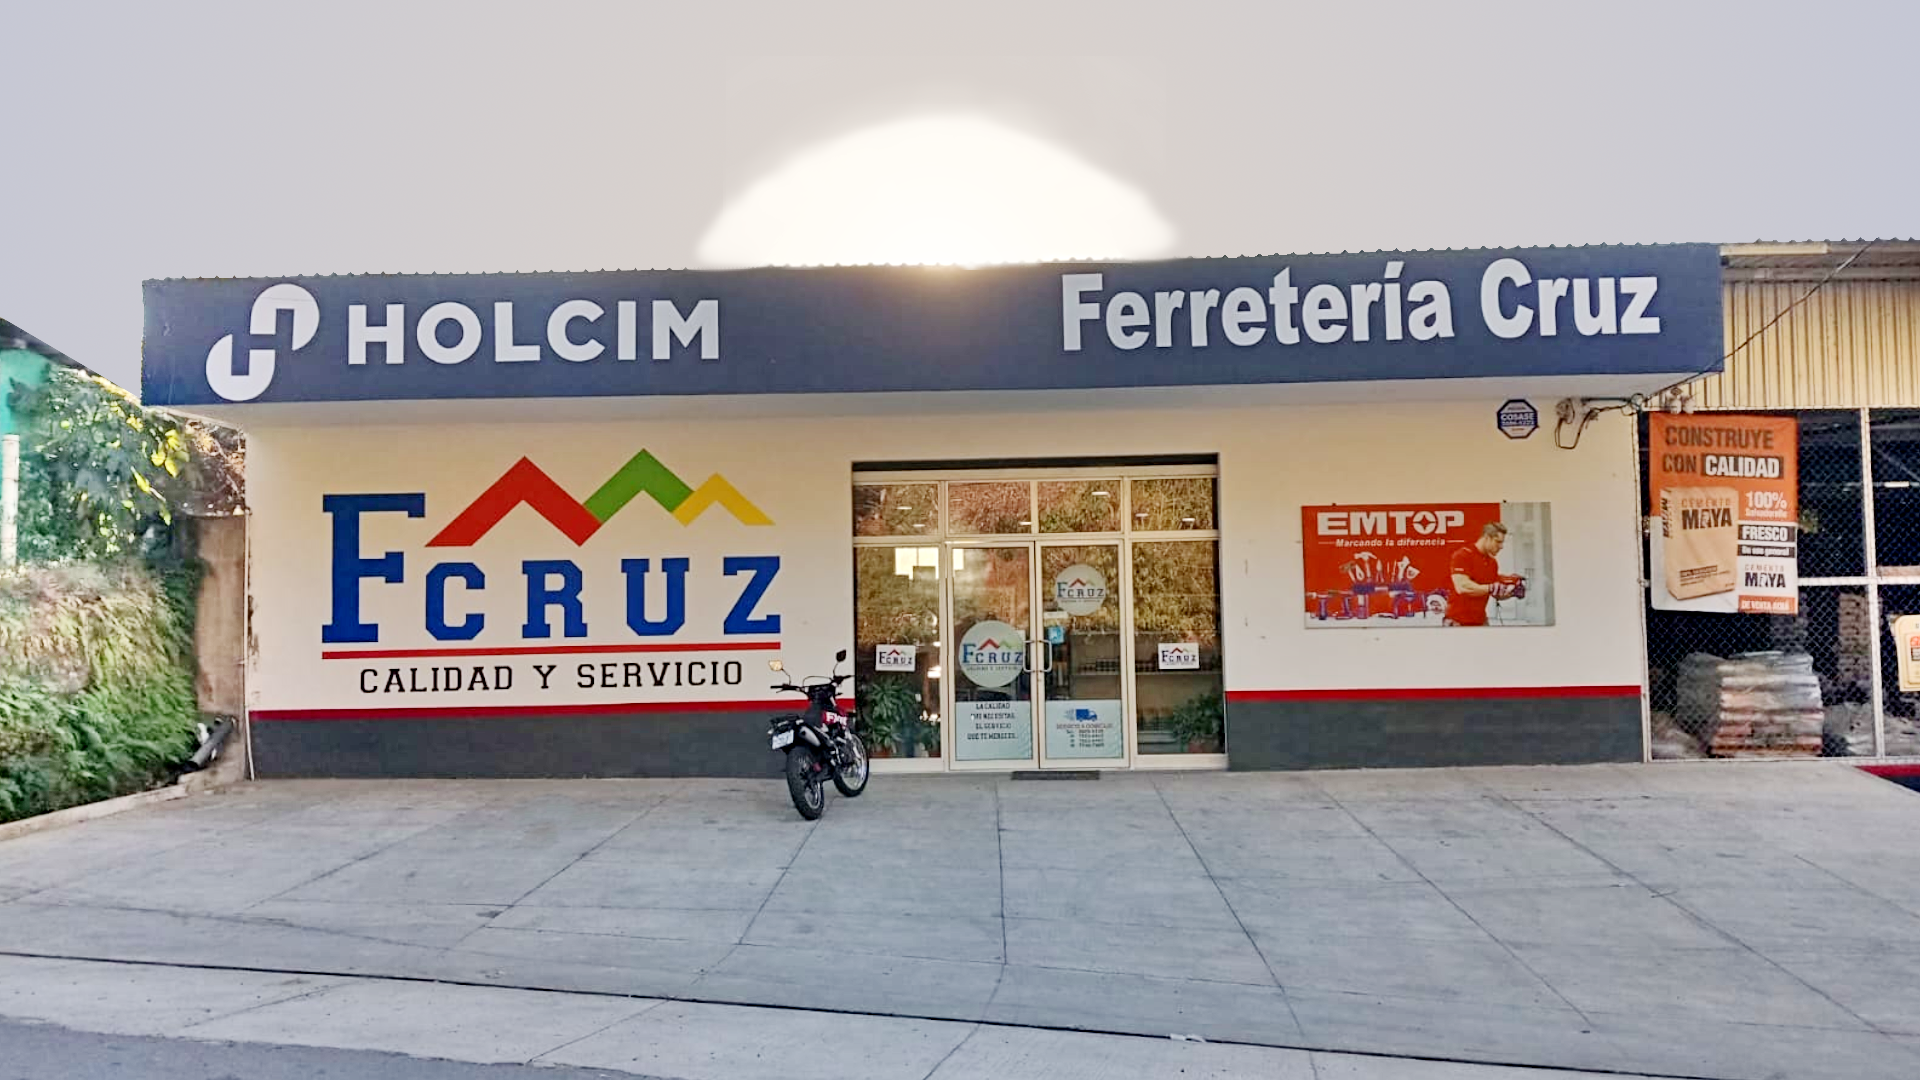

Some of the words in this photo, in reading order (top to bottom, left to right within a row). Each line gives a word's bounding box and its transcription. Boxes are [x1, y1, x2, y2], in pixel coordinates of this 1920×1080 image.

[1061, 261, 1455, 351] Ferretería
[1480, 258, 1661, 339] Cruz
[348, 299, 720, 365] HOLCIM
[1665, 426, 1774, 450] CONSTRUYE
[1662, 453, 1696, 473] CON
[1705, 455, 1780, 478] CALIDAD
[1745, 491, 1788, 509] 100%
[1317, 510, 1465, 535] EMTOP
[1682, 508, 1732, 530] MAYA
[1335, 538, 1383, 547] Marcando
[1385, 538, 1395, 547] la
[1396, 537, 1446, 547] diferencia
[1742, 526, 1788, 542] FRESCO
[321, 492, 781, 643] FCRUZ
[1745, 564, 1785, 572] CEMENTO
[1745, 572, 1786, 588] MAYA
[360, 665, 513, 693] CALIDAD
[533, 664, 557, 689] Y
[577, 661, 743, 688] SERVICIO
